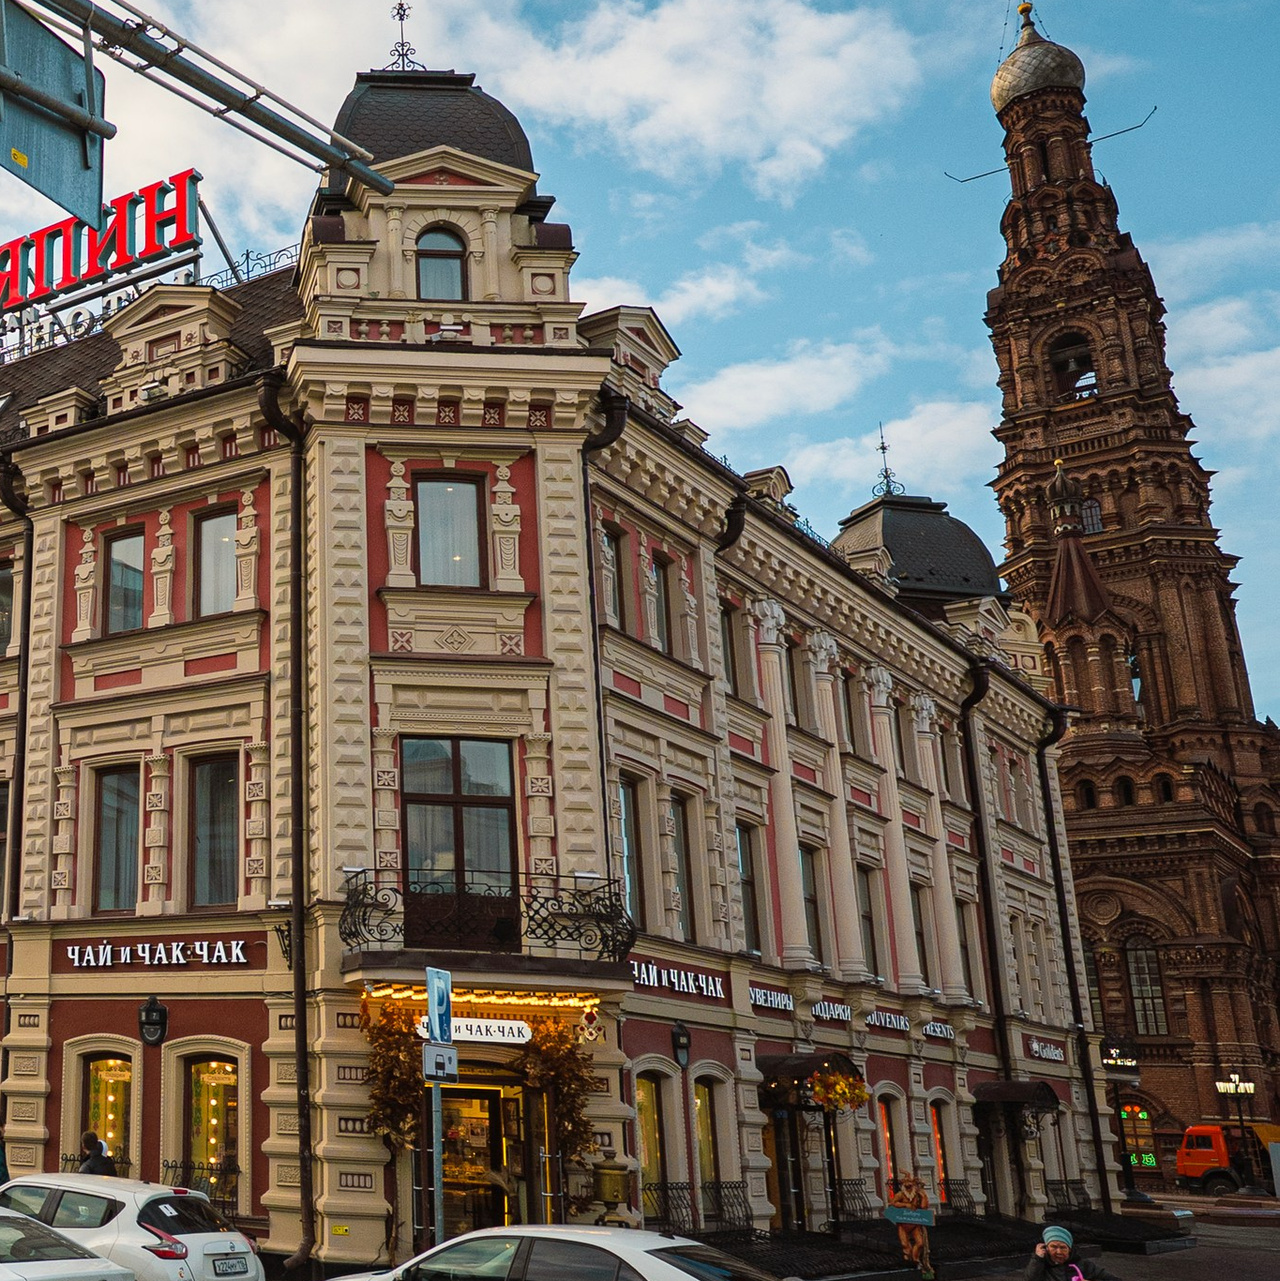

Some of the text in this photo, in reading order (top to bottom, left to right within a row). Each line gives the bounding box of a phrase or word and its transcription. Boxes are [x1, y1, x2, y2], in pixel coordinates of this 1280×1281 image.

[67, 940, 112, 967] ЧАЙ
[121, 946, 131, 963] и
[749, 986, 794, 1011] УВЕНИРЫ
